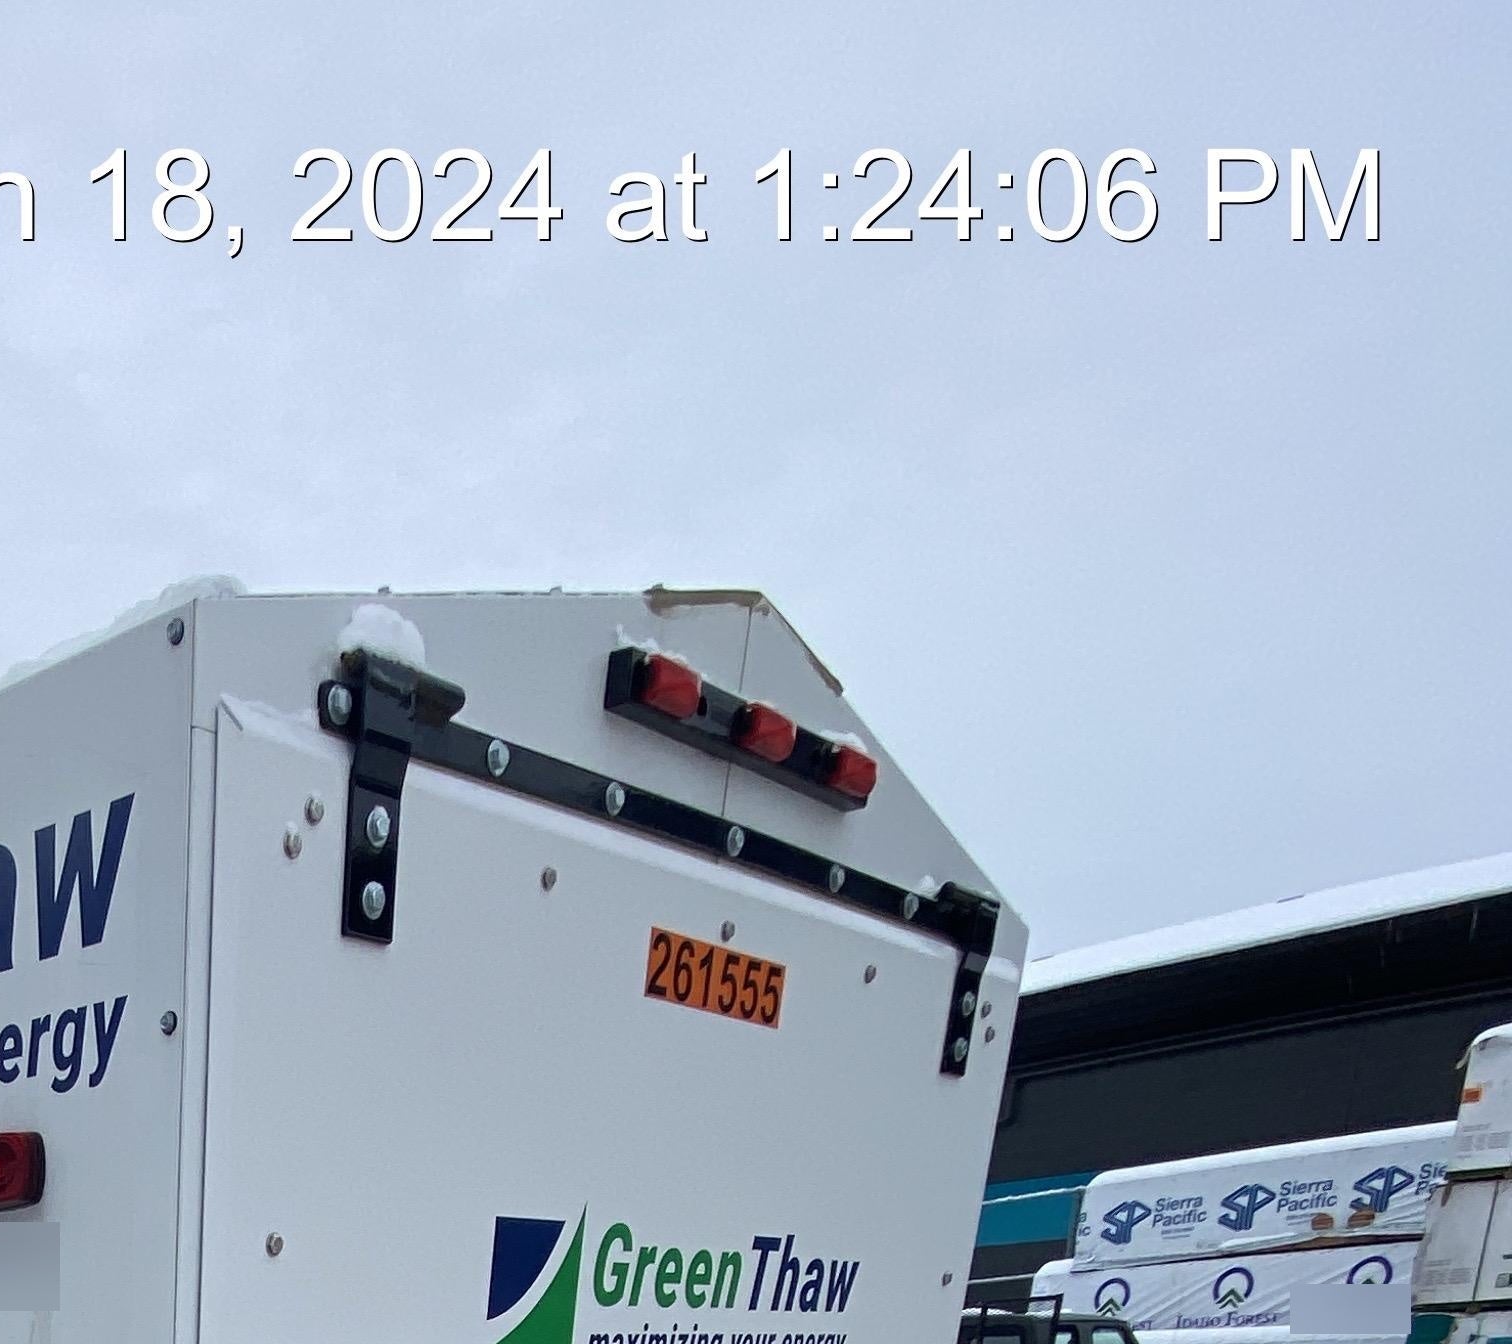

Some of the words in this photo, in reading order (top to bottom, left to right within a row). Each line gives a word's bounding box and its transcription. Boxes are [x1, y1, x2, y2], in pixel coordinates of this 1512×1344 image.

[647, 932, 784, 1025] 261555
[1279, 1179, 1334, 1197] Sierra
[1154, 1196, 1204, 1213] Sierra
[1276, 1193, 1338, 1213] Pacific
[1152, 1209, 1208, 1228] Pacific
